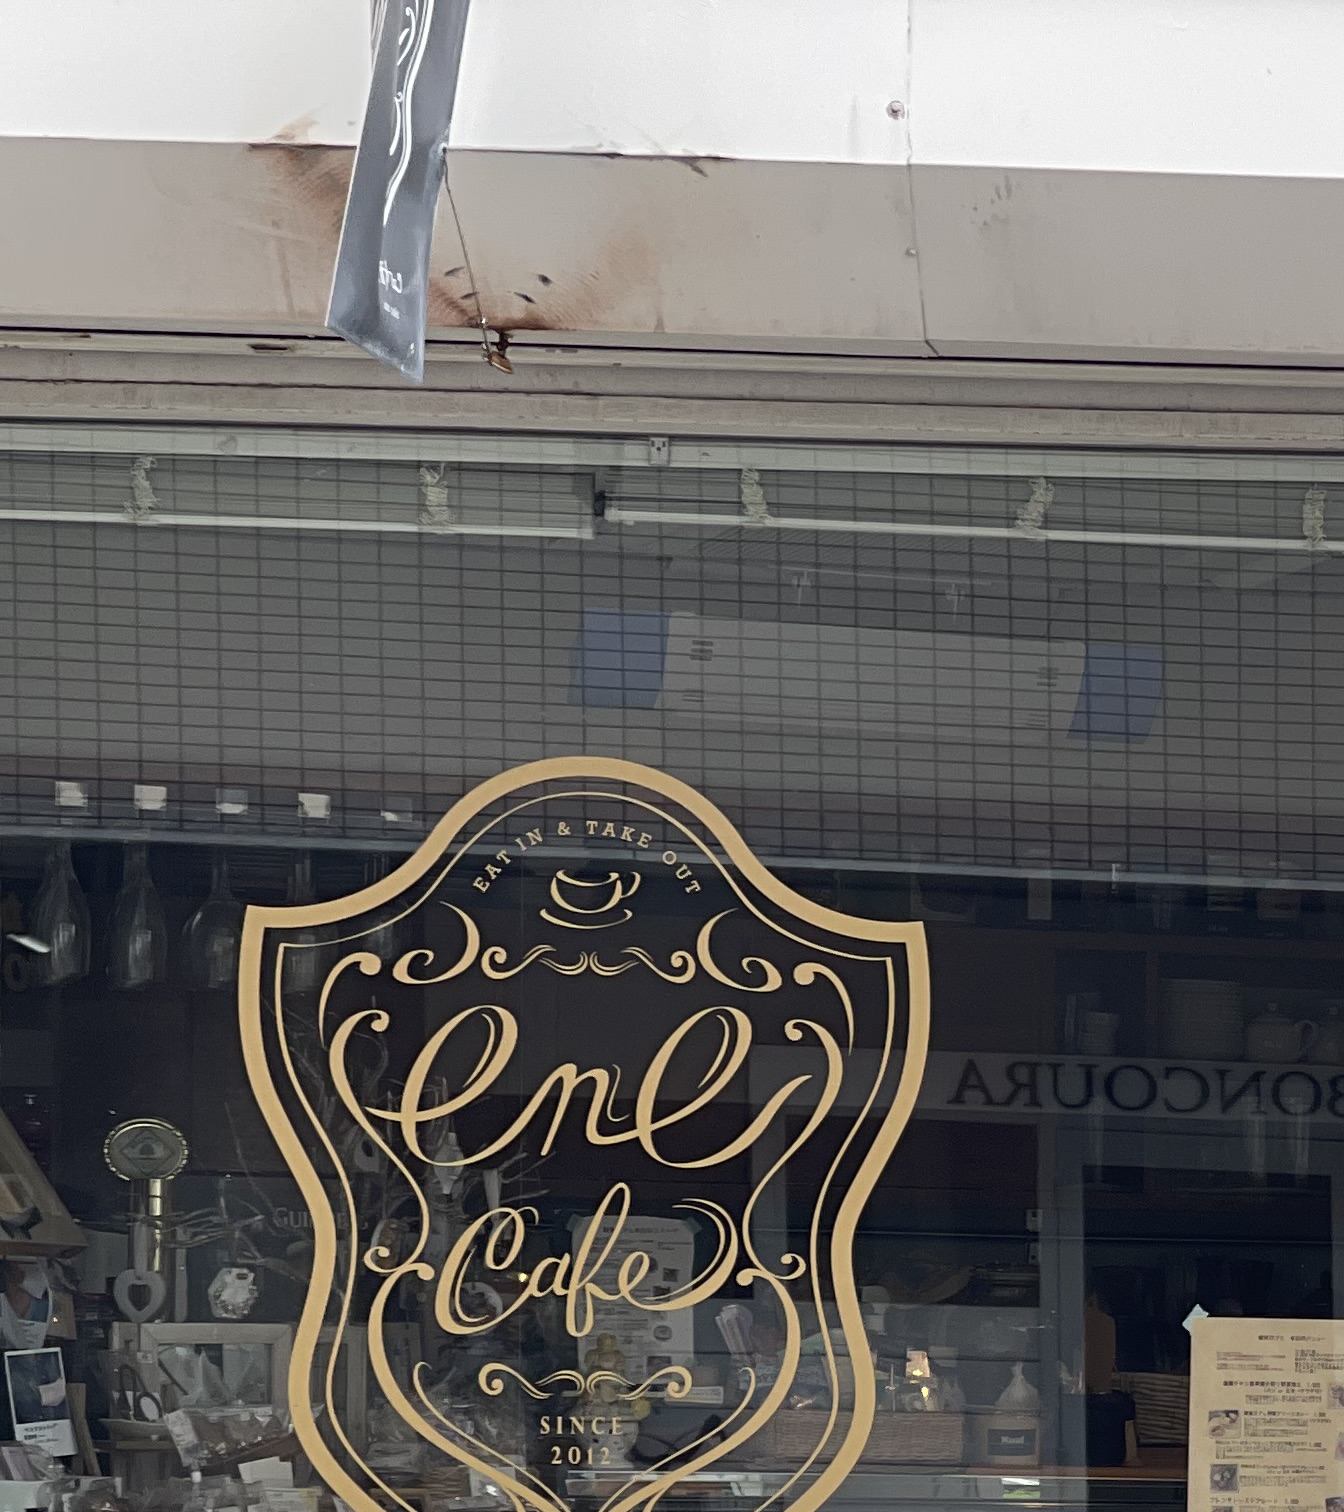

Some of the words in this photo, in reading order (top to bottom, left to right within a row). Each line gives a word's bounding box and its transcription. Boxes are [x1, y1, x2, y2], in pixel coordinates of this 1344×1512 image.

[473, 850, 511, 893] EAT
[515, 828, 544, 851] IN
[558, 821, 571, 835] &
[586, 820, 652, 848] TAKE
[662, 850, 701, 894] OUT
[540, 1416, 623, 1436] SINCE
[551, 1446, 611, 1465] 2012
